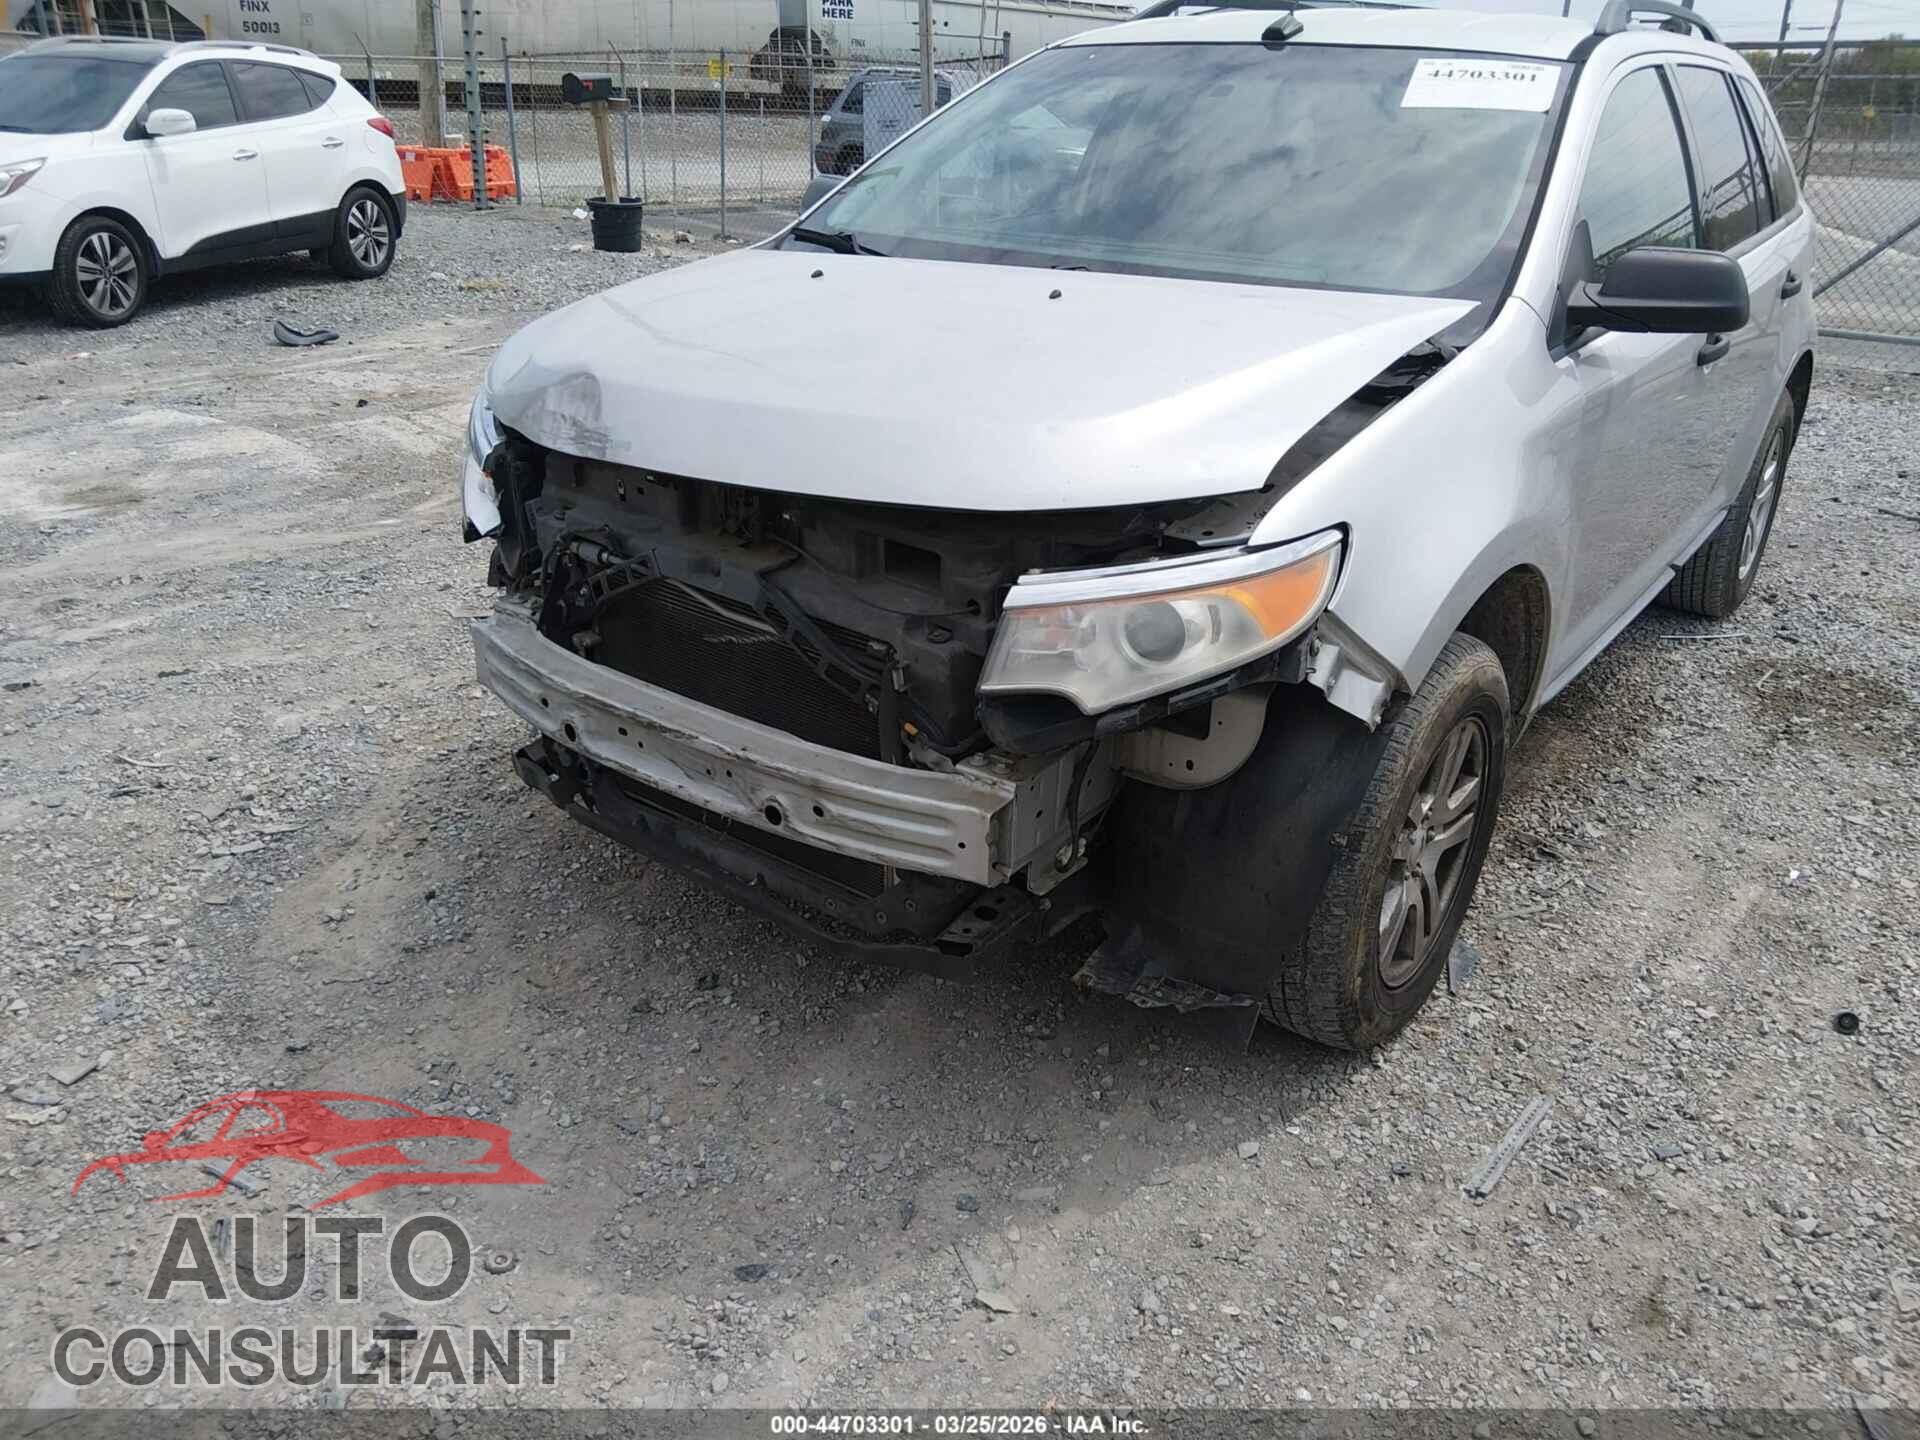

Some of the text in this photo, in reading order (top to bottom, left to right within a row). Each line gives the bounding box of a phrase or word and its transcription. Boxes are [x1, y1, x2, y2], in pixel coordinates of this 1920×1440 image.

[240, 0, 270, 12] FINX
[822, 8, 854, 19] HERE
[242, 20, 280, 33] 50013
[1427, 69, 1538, 82] 44703301
